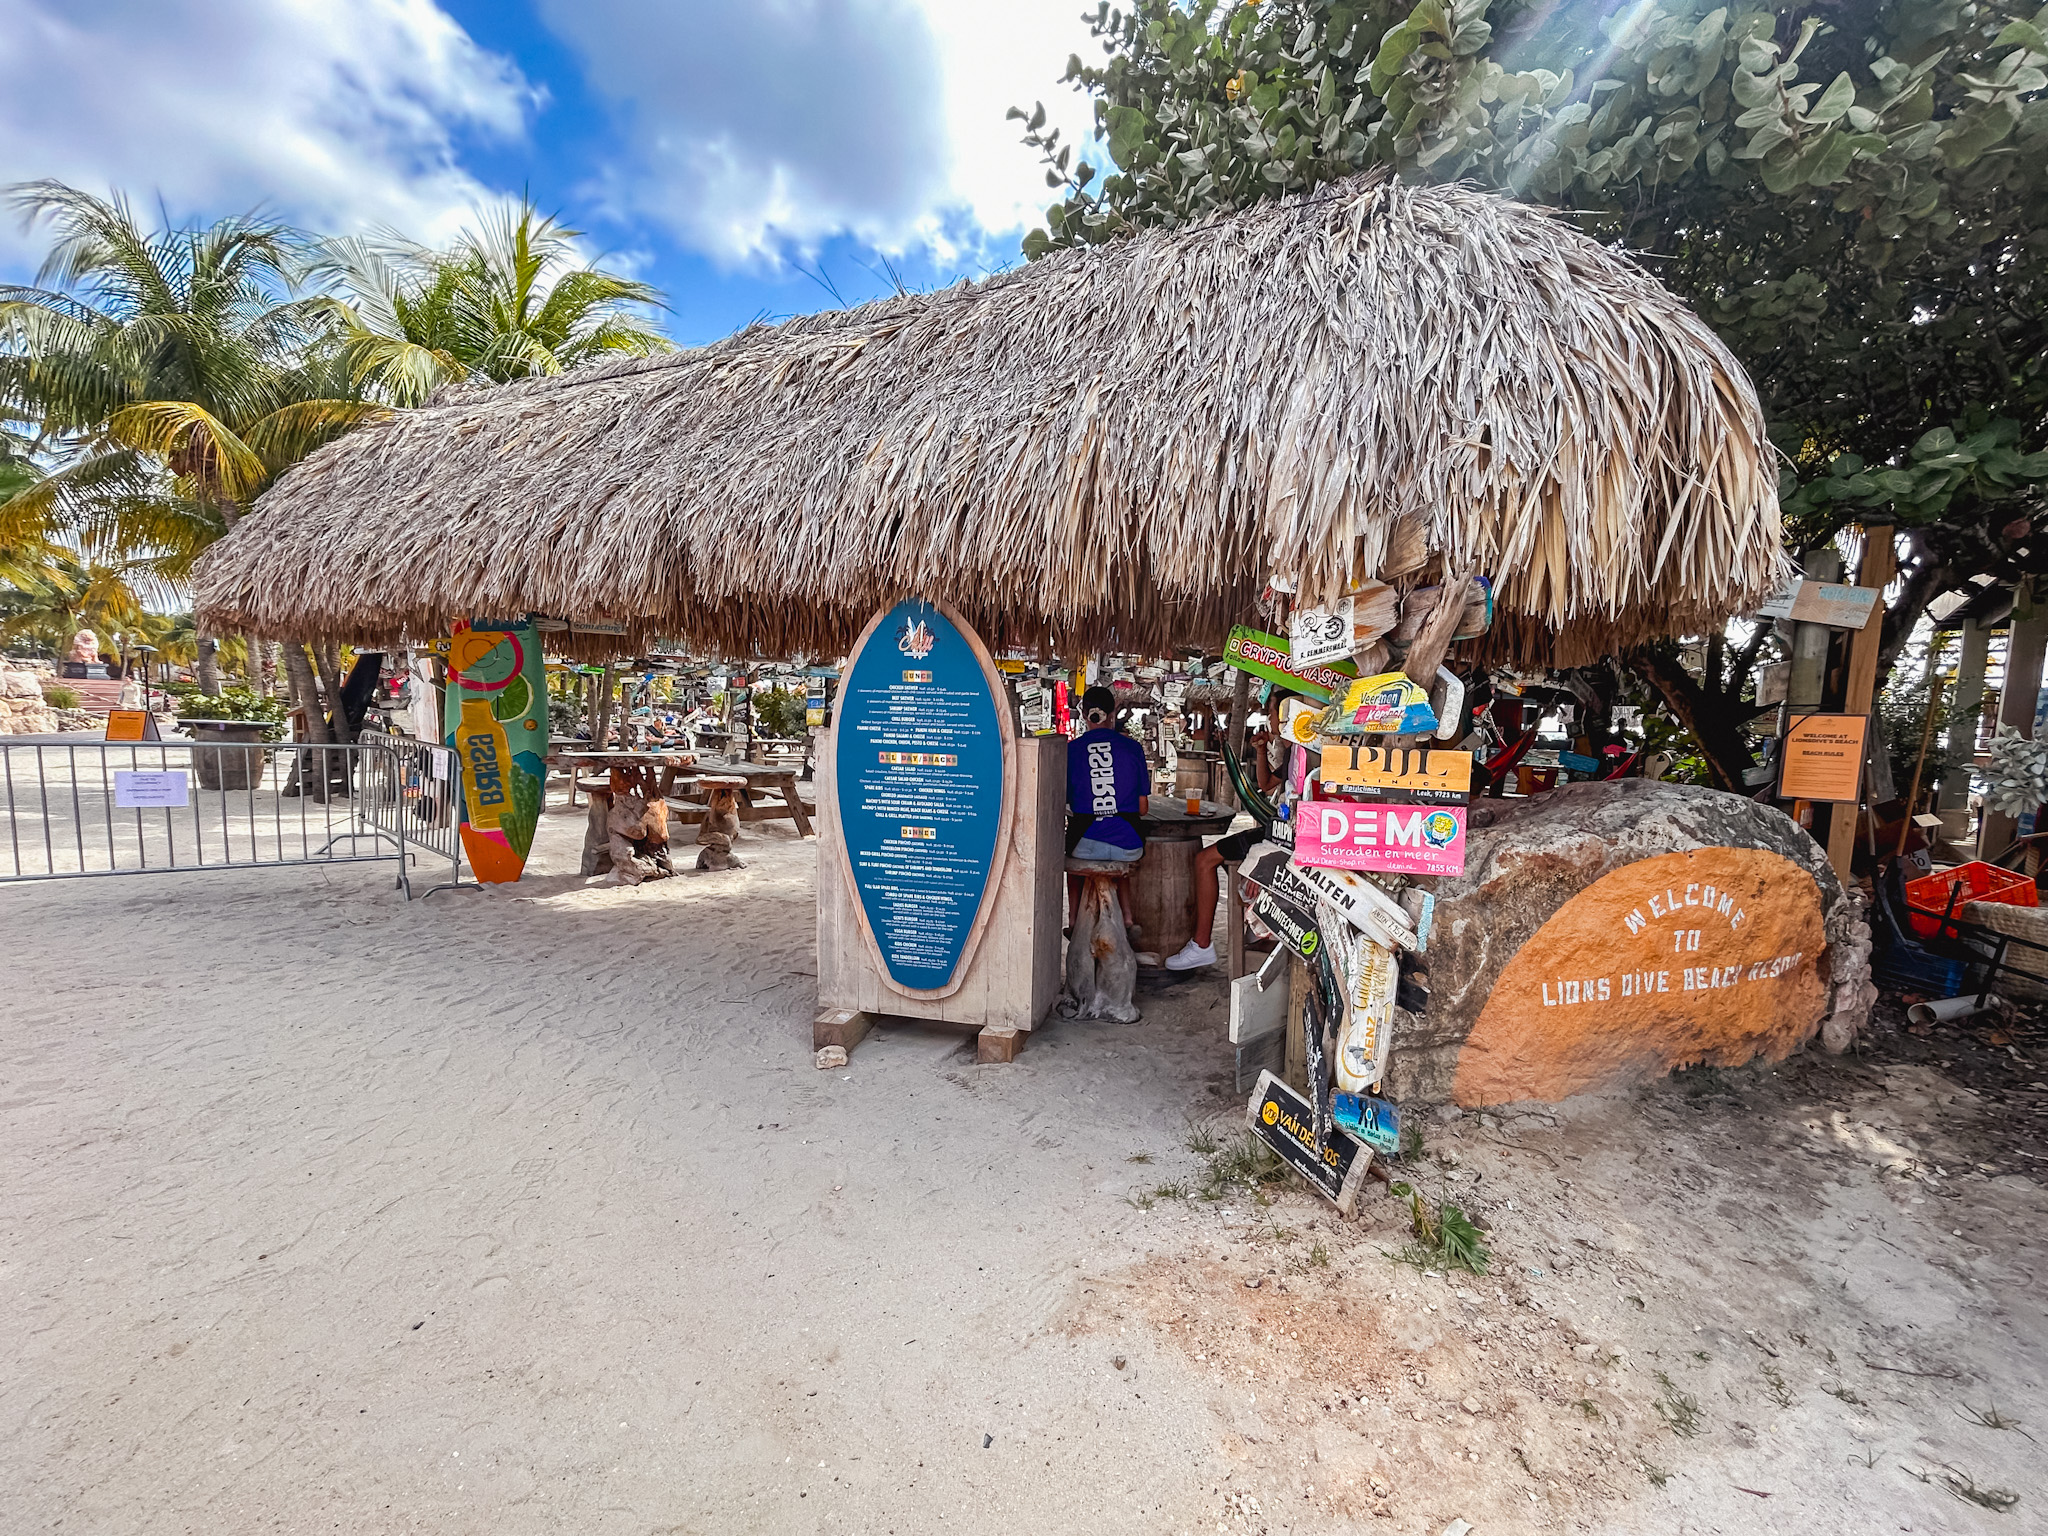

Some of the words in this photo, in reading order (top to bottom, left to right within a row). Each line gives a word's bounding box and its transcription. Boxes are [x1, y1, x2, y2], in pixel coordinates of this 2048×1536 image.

[901, 755, 957, 763] DAY/SNACKS
[1347, 748, 1448, 777] PIJL
[1346, 776, 1446, 788] CLINICS
[1272, 820, 1292, 842] RALPH
[1321, 844, 1380, 857] Sieraden
[1404, 851, 1439, 861] meer
[1427, 864, 1445, 872] 7855
[1272, 878, 1317, 904] MOMENT
[1300, 866, 1356, 910] AALTEN
[1623, 882, 1746, 935] WELCOME
[1674, 929, 1701, 953] TO
[1683, 965, 1743, 991] BEACH
[1364, 1016, 1376, 1060] BENZ
[1279, 1110, 1300, 1134] VAN
